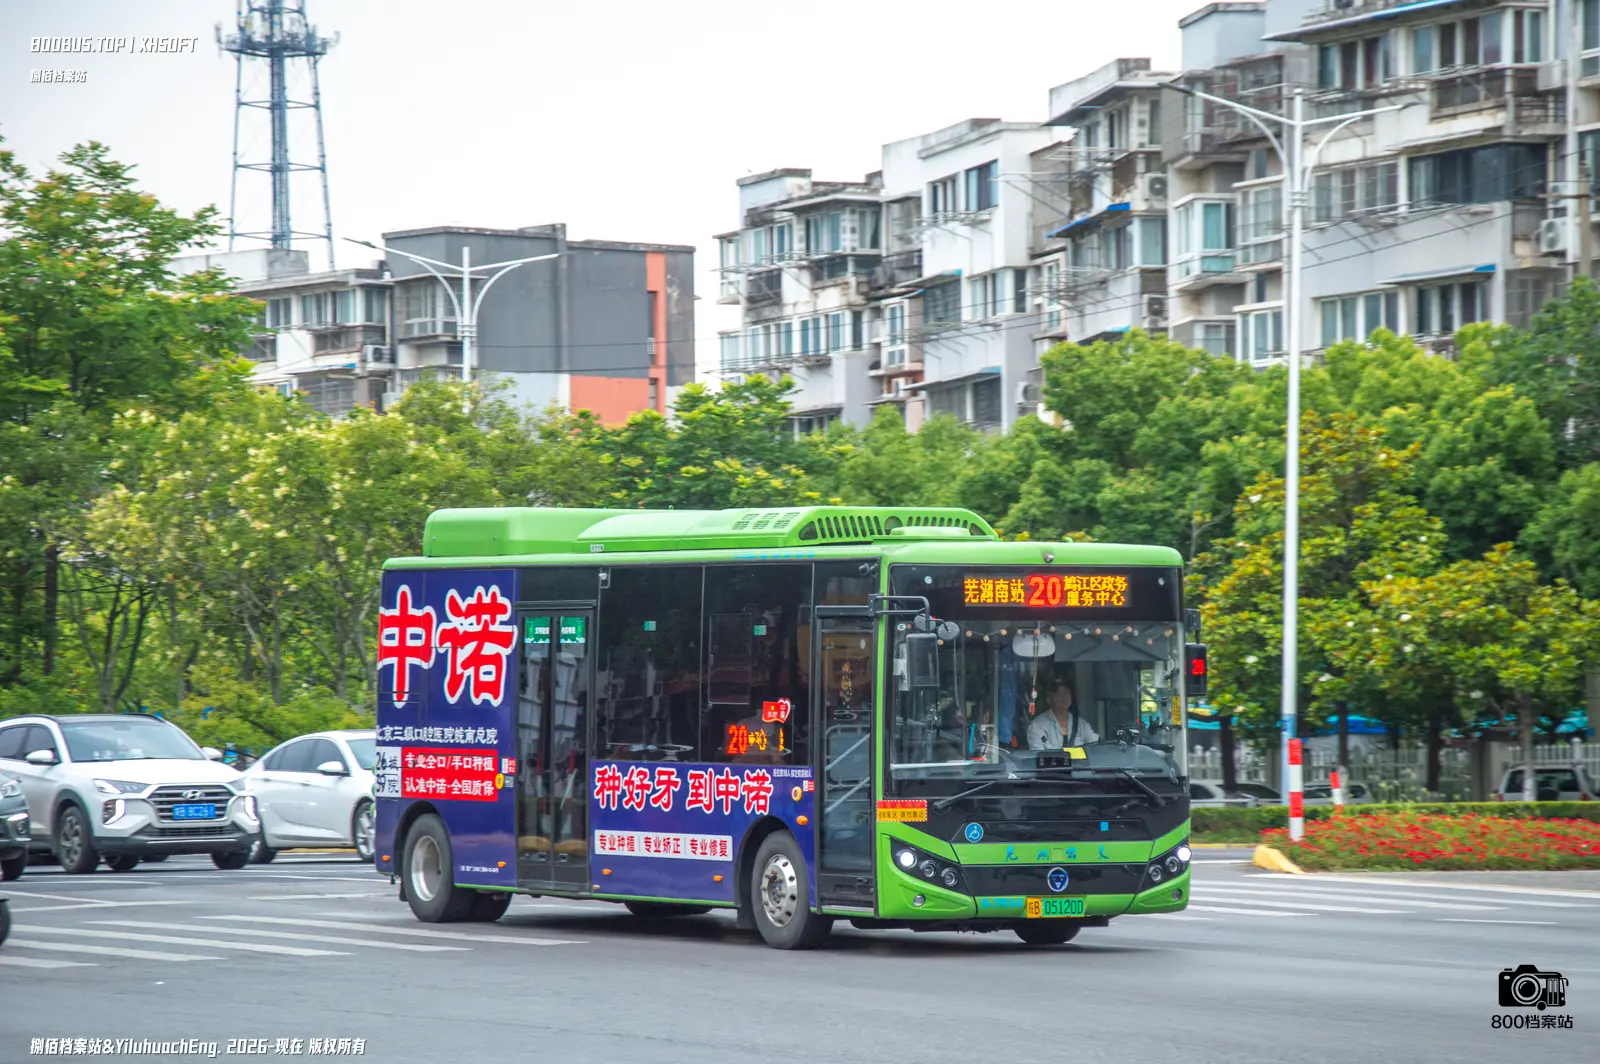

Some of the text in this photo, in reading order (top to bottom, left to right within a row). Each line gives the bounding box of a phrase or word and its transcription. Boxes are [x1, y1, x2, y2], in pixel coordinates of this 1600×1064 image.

[964, 578, 1025, 603] 芜湖南站
[1028, 575, 1063, 607] 20
[377, 584, 519, 708] 中诺
[727, 724, 748, 754] 20
[593, 764, 774, 815] 种好牙 到中诺
[599, 834, 728, 857] 专业种植 专业矫正 专业修复
